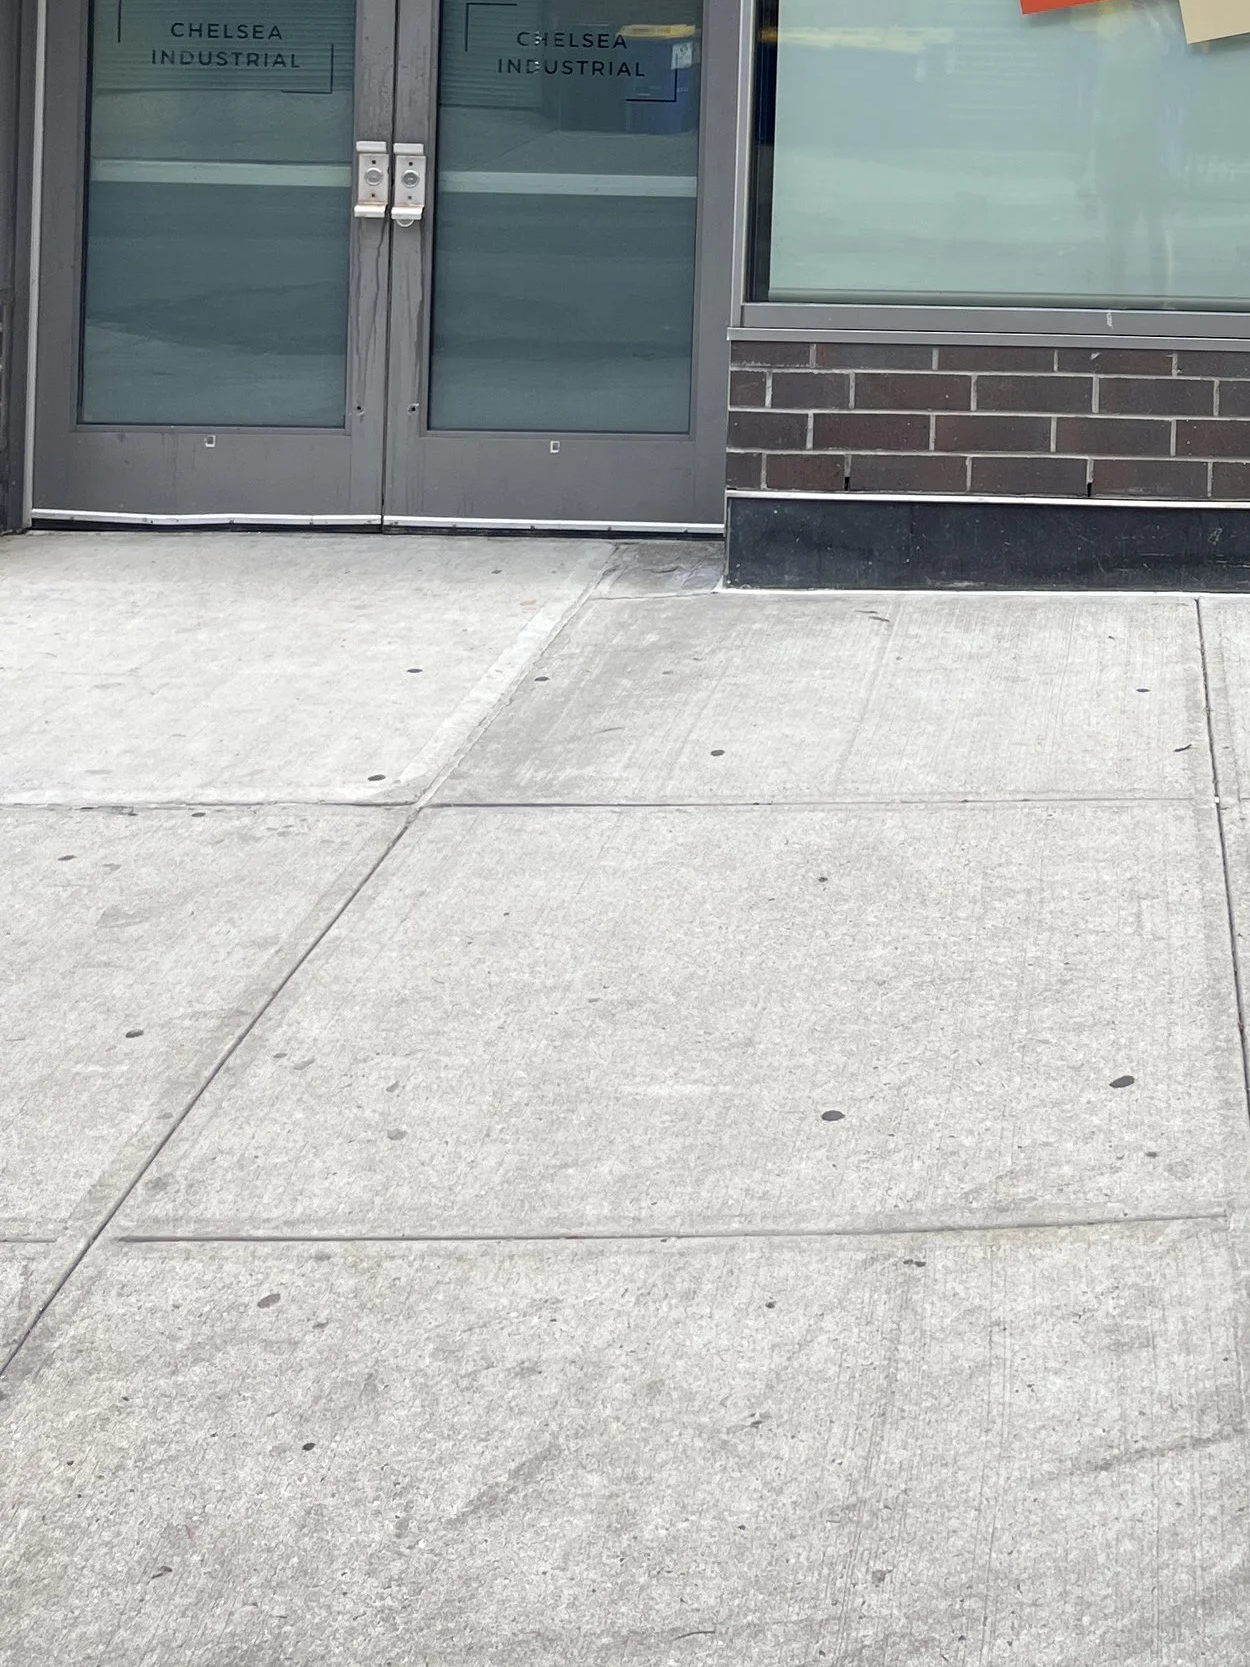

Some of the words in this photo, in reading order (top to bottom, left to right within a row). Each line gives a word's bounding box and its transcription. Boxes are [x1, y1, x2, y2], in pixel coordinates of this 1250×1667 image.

[170, 22, 283, 40] CHELSEA
[516, 31, 628, 49] CHELSEA
[151, 49, 300, 68] INDUSTRIAL
[497, 58, 645, 77] INDUSTRIAL
